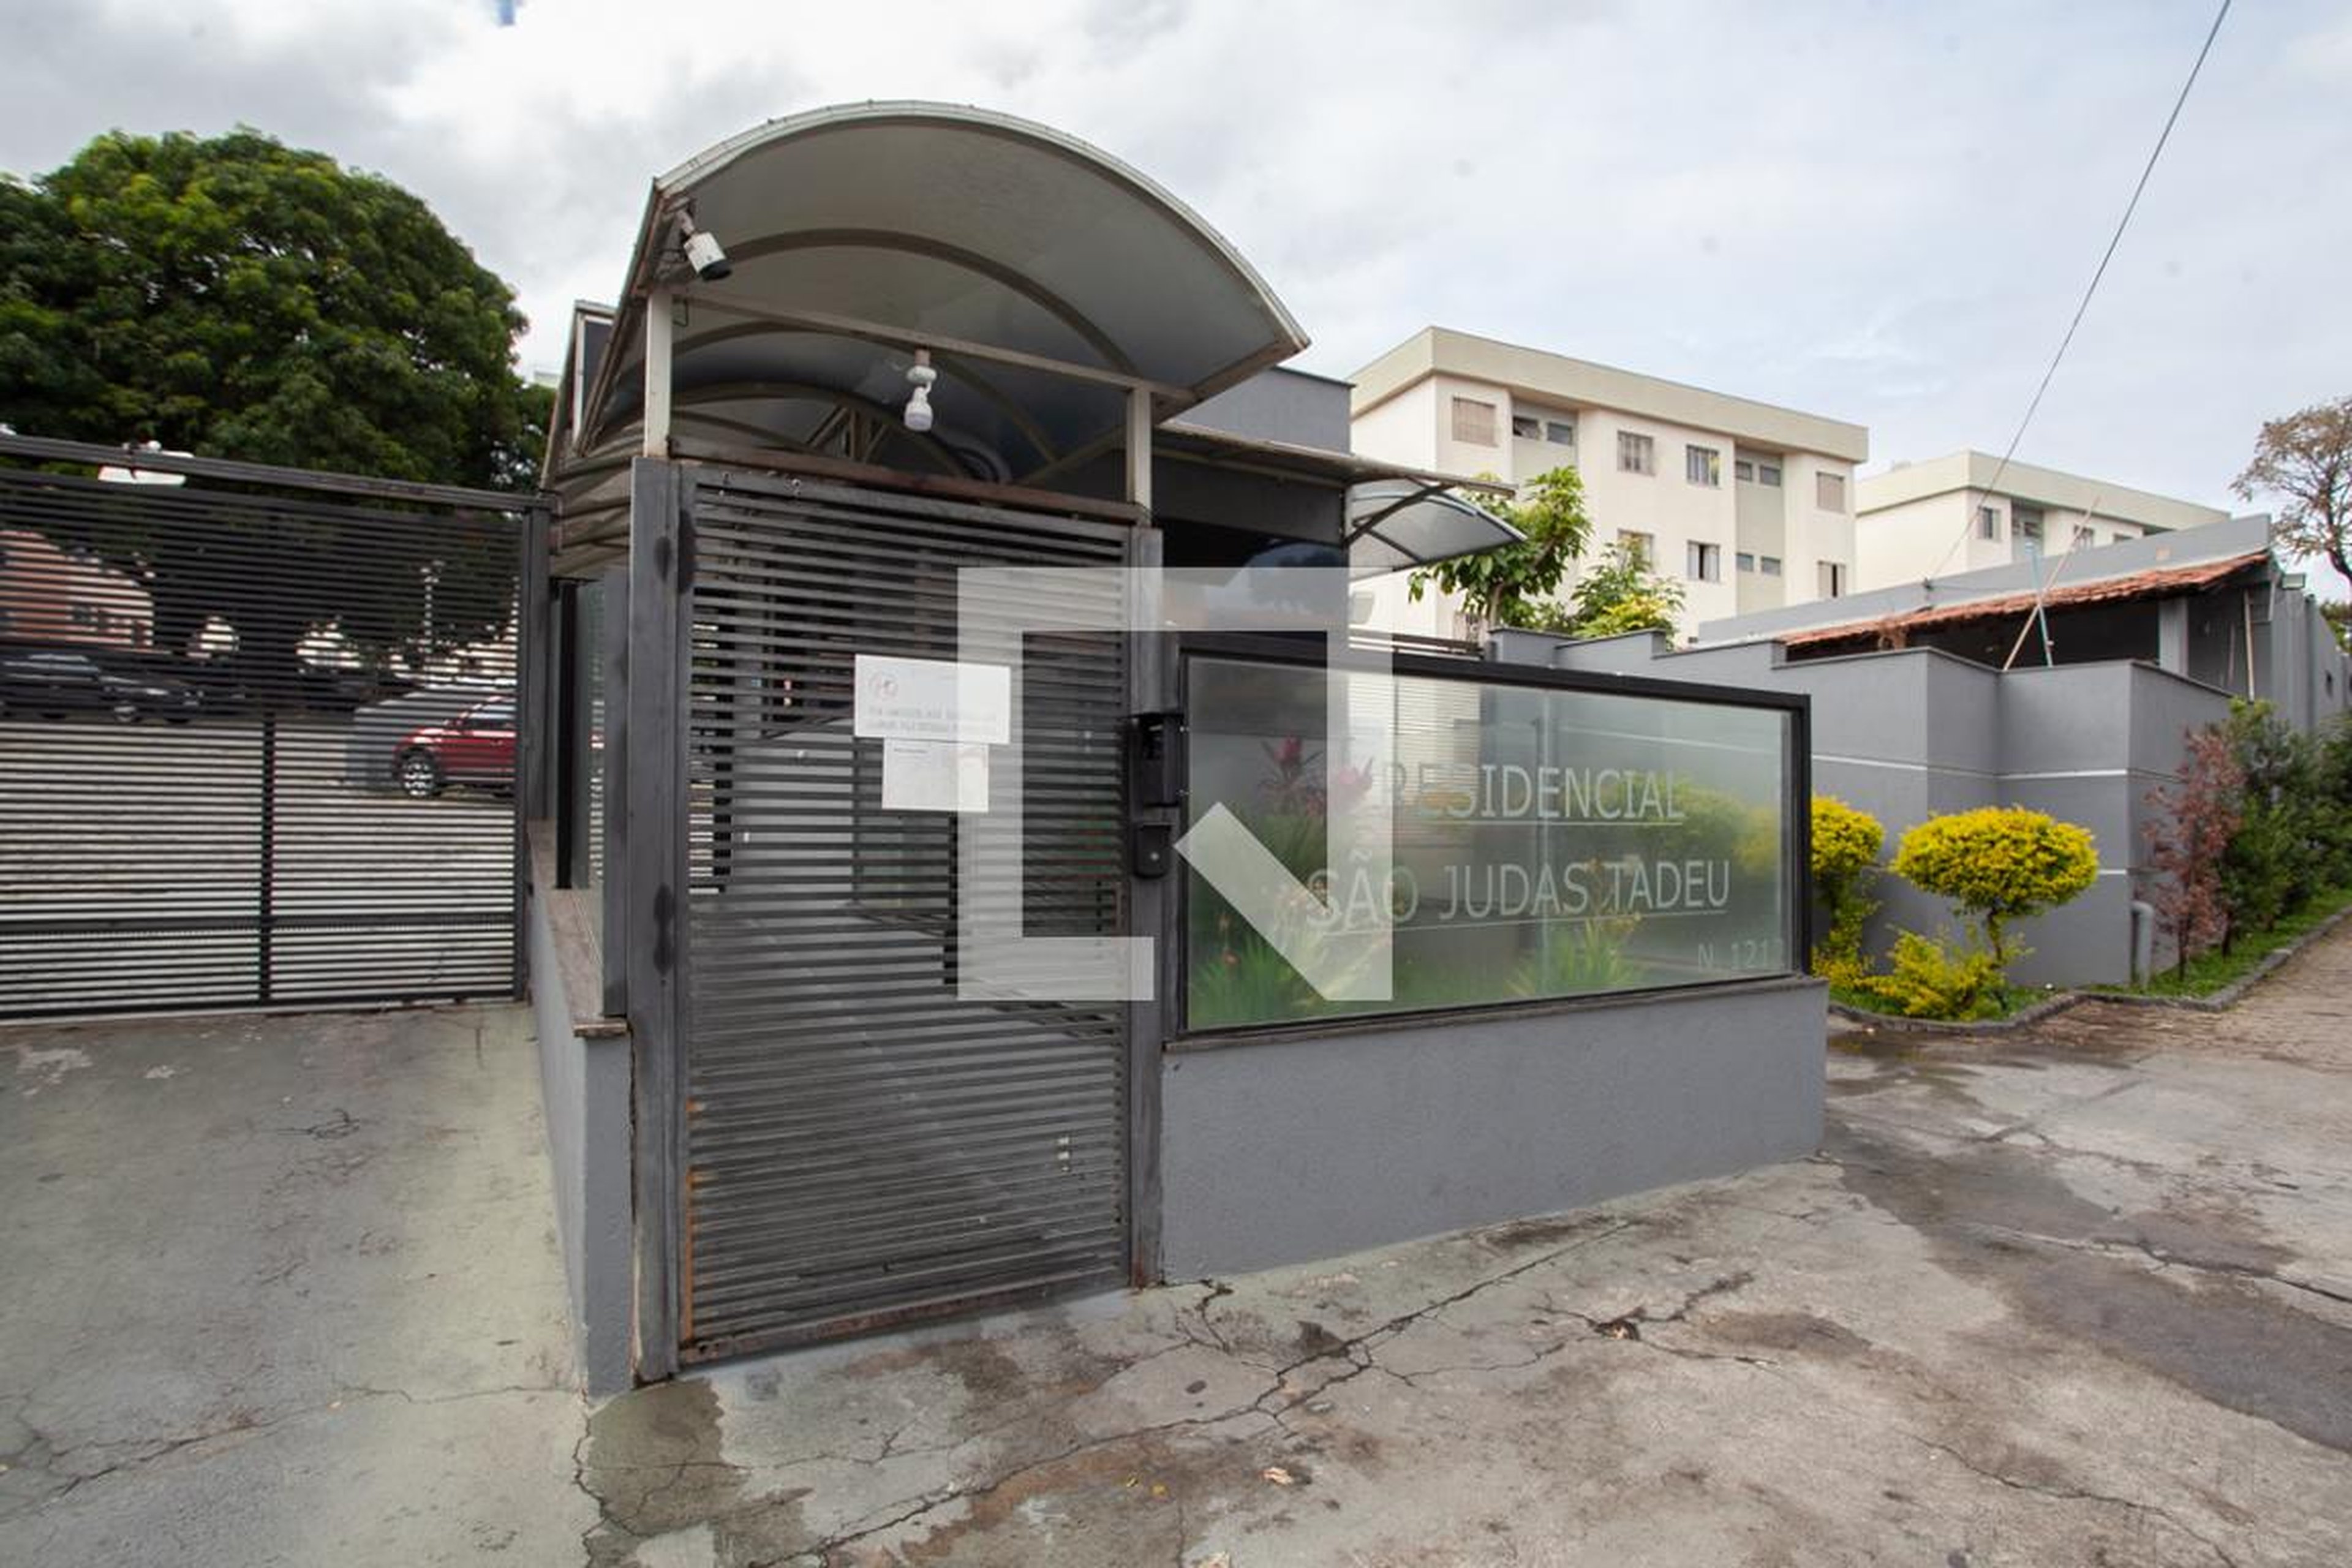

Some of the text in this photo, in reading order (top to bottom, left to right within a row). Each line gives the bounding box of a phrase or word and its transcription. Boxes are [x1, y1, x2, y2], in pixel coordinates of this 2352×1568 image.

[1384, 764, 1686, 819] RESIDENCIAL
[1306, 848, 1730, 929] SÃO JUDAS TADEU
